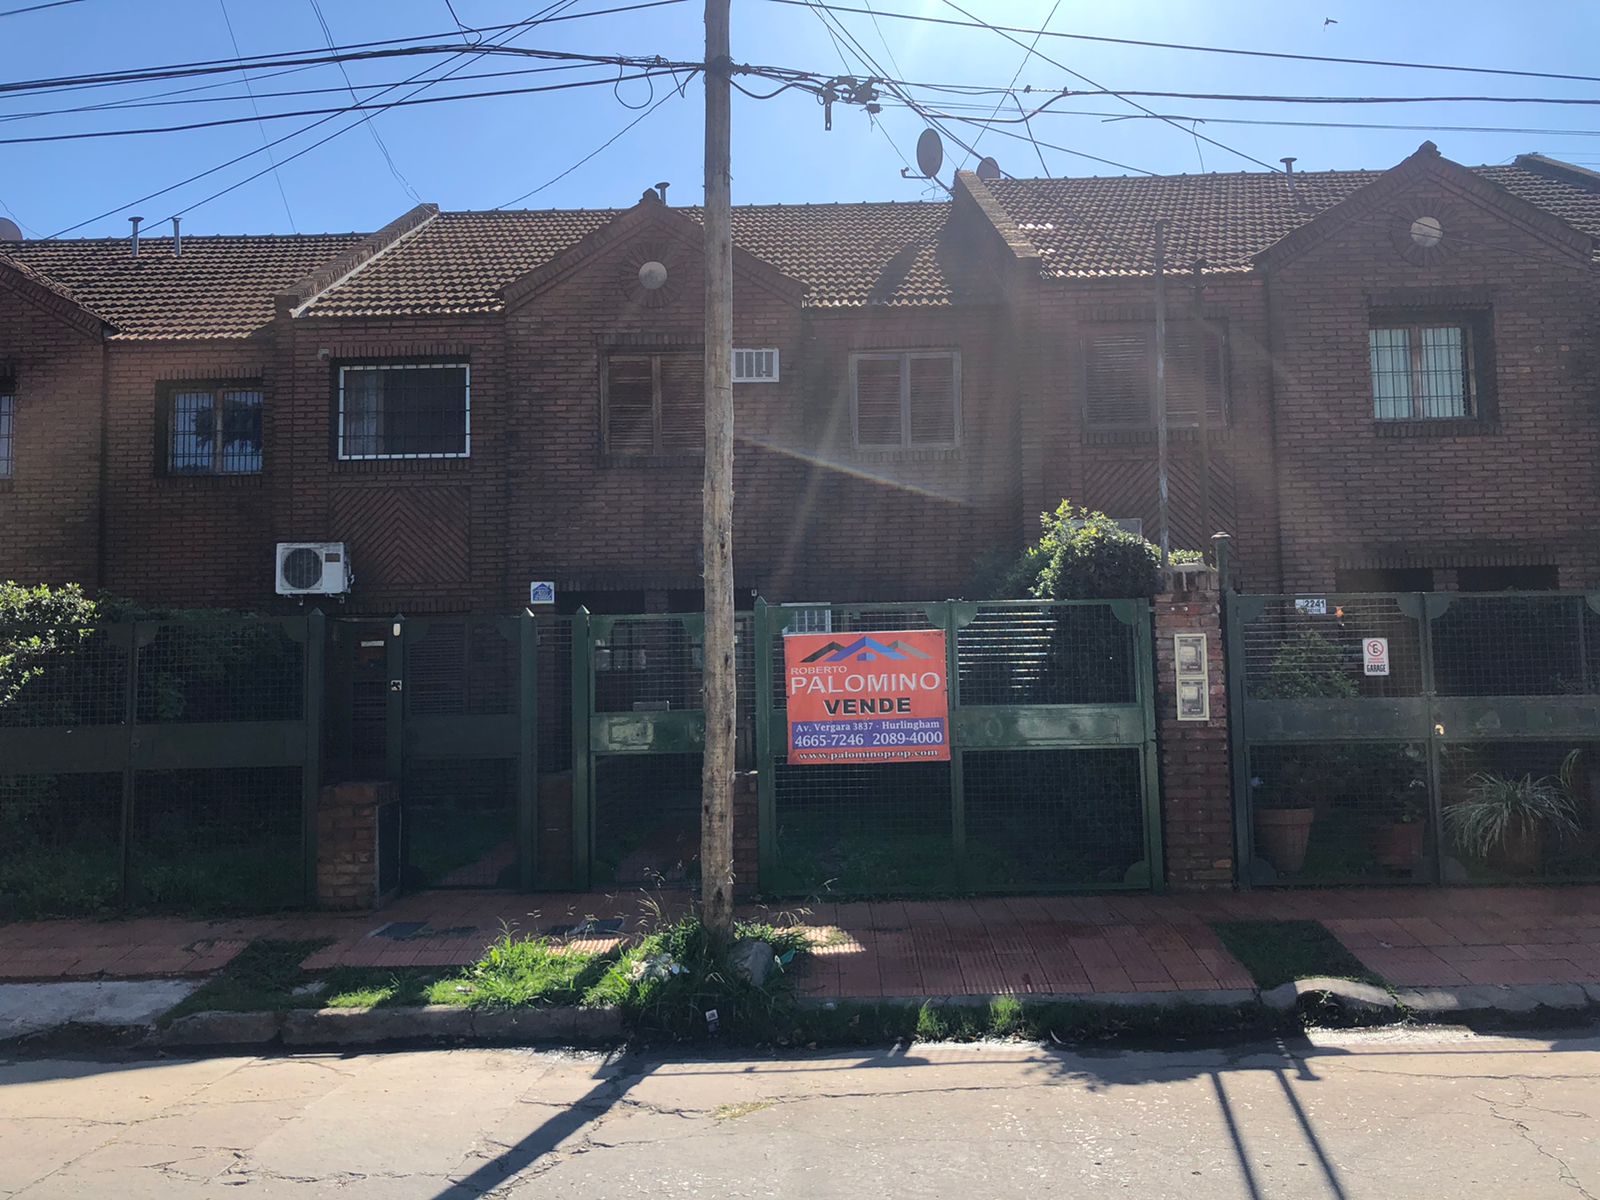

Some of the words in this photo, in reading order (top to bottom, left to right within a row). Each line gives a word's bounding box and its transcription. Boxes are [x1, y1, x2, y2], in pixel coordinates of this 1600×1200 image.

[1304, 599, 1325, 607] 2241
[790, 665, 847, 674] ROBERTO
[1367, 664, 1386, 672] GARAGE
[791, 672, 940, 695] PALOMINO
[823, 697, 912, 716] VENDE
[795, 724, 812, 733] Av.
[814, 722, 851, 734] Vergara
[852, 722, 873, 731] 3837
[881, 720, 940, 731] Hurlingham
[795, 733, 864, 747] 4665-7246
[872, 731, 943, 745] 2089-4000
[799, 750, 937, 760] www.palominoprop.com
